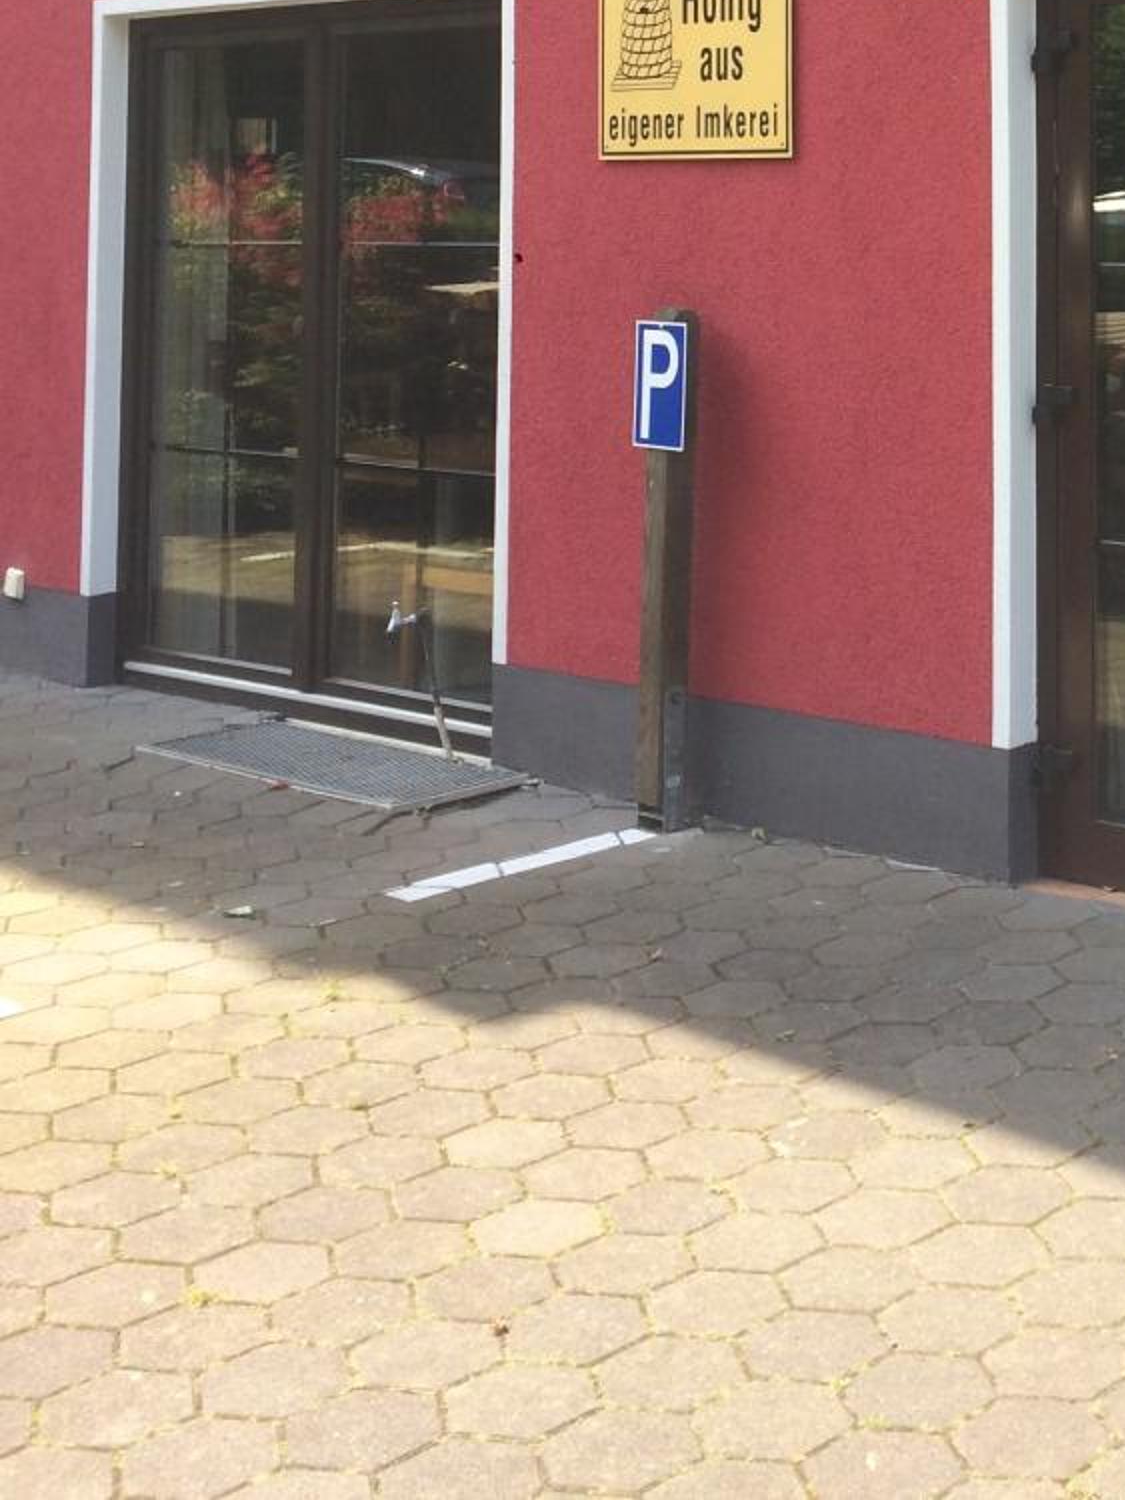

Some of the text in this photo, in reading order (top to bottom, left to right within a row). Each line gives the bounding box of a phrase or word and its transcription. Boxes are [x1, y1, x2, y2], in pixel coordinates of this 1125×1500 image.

[700, 45, 744, 82] aus
[609, 103, 778, 147] eigener Imkerei
[640, 328, 679, 439] P
